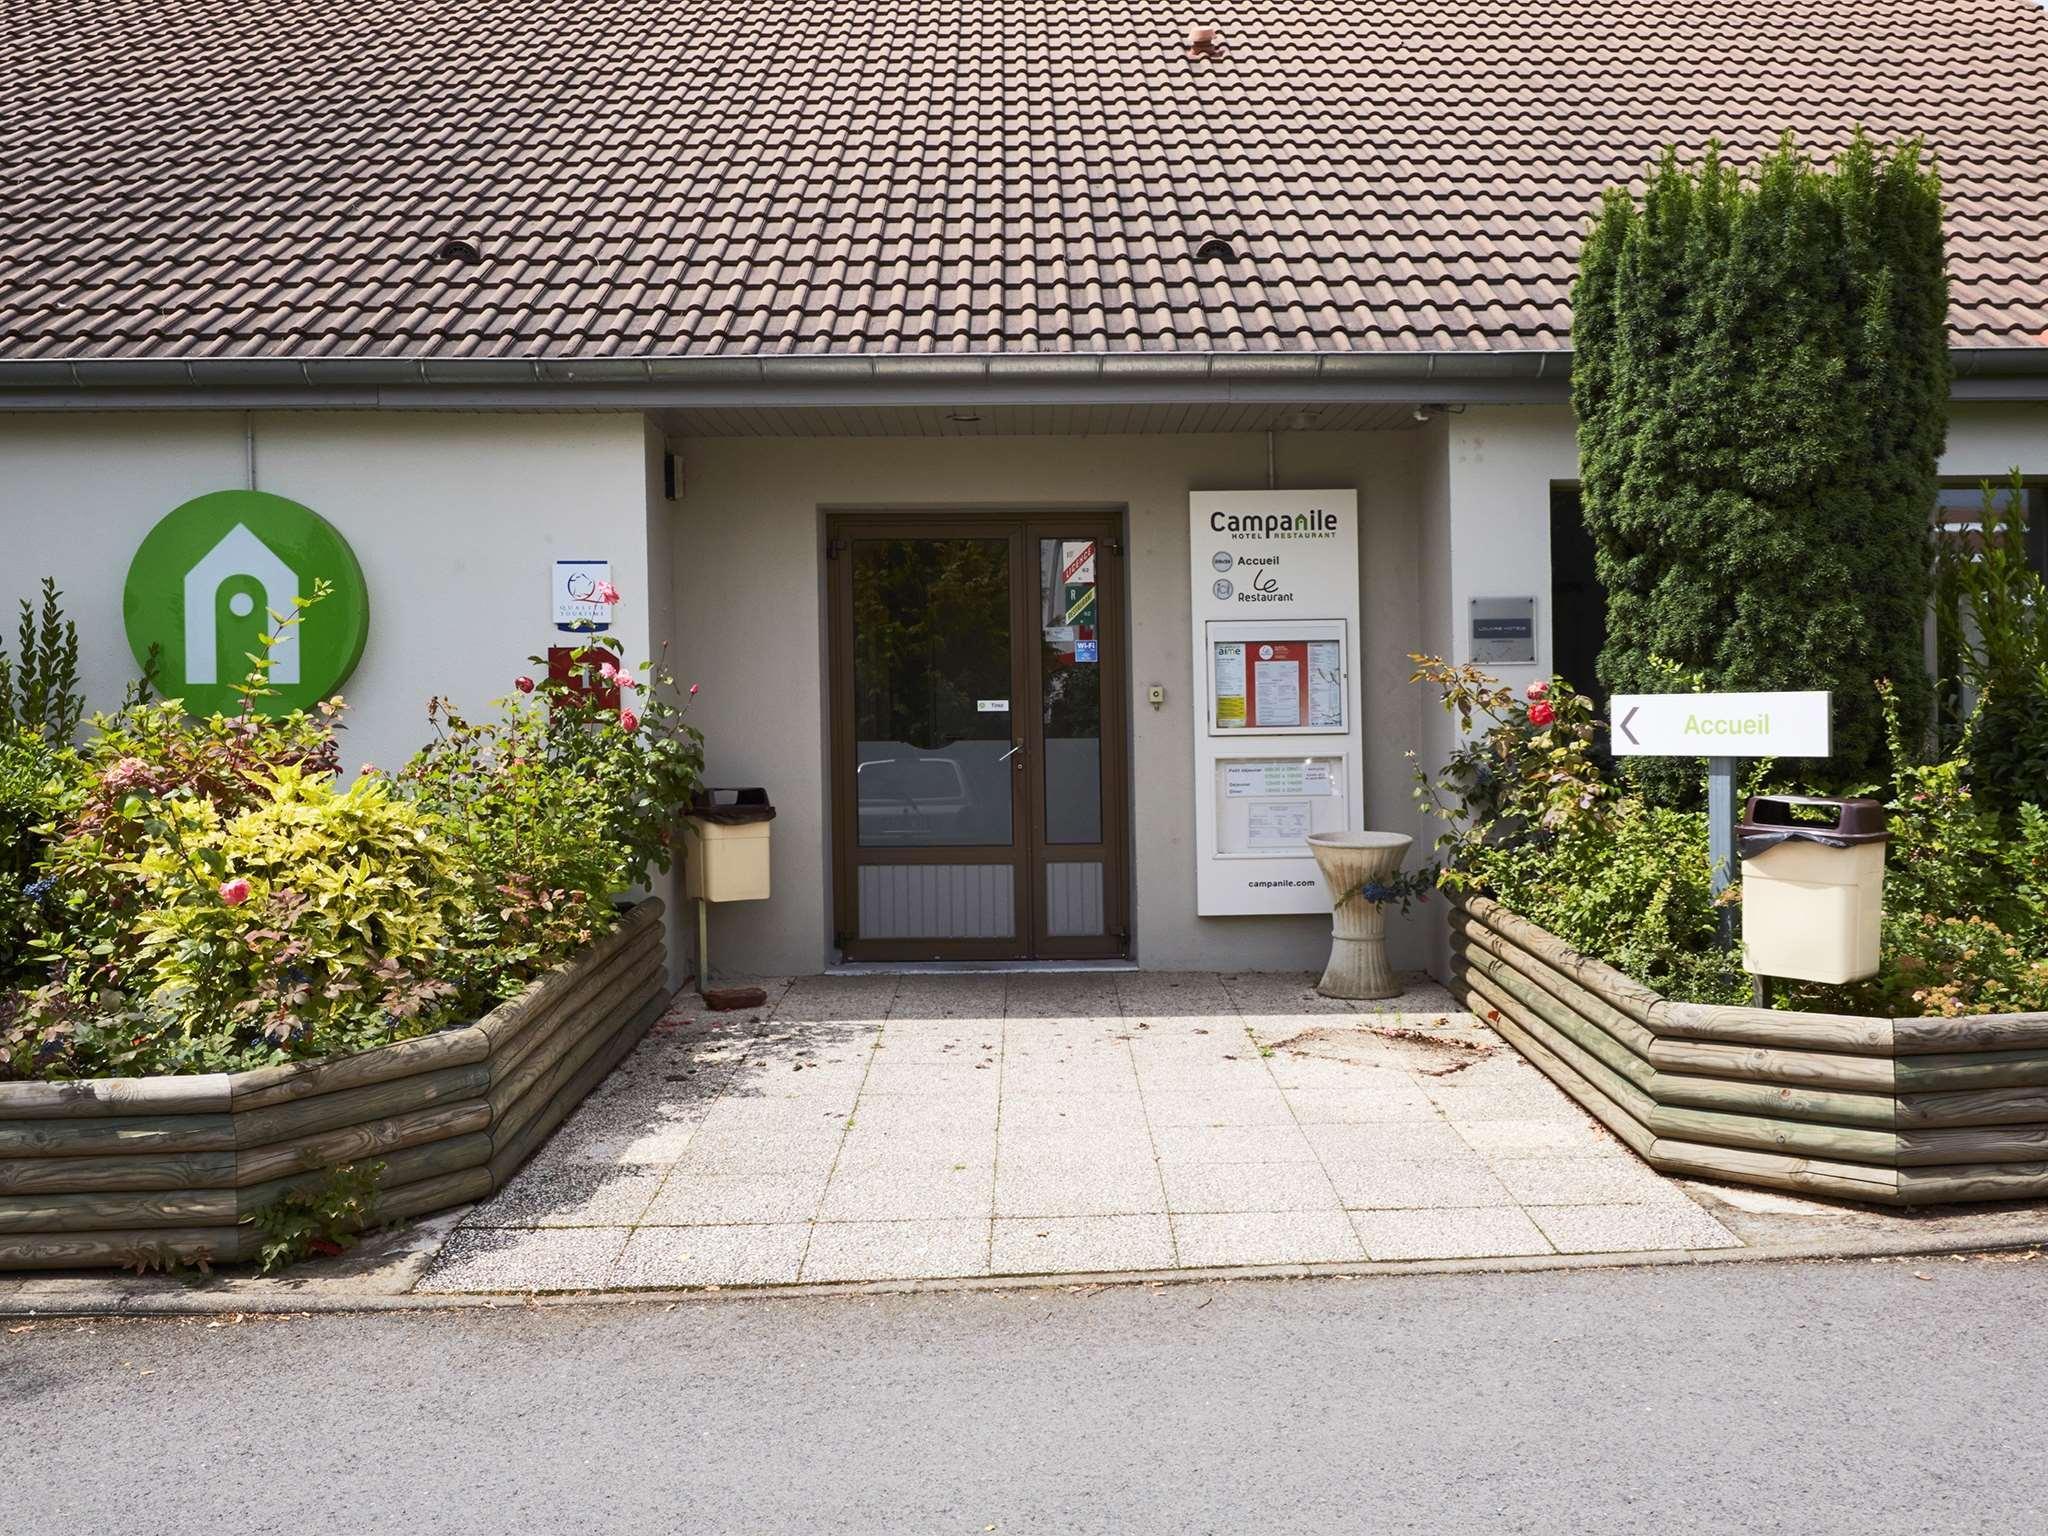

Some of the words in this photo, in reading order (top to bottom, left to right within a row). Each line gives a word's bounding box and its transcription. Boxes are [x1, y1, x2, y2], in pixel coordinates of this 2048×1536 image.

[1210, 509, 1338, 539] Campanile
[1237, 556, 1280, 566] Accueil
[1238, 592, 1294, 602] Restaurant
[1683, 713, 1771, 735] Accueil
[1248, 879, 1315, 888] campanile.com
